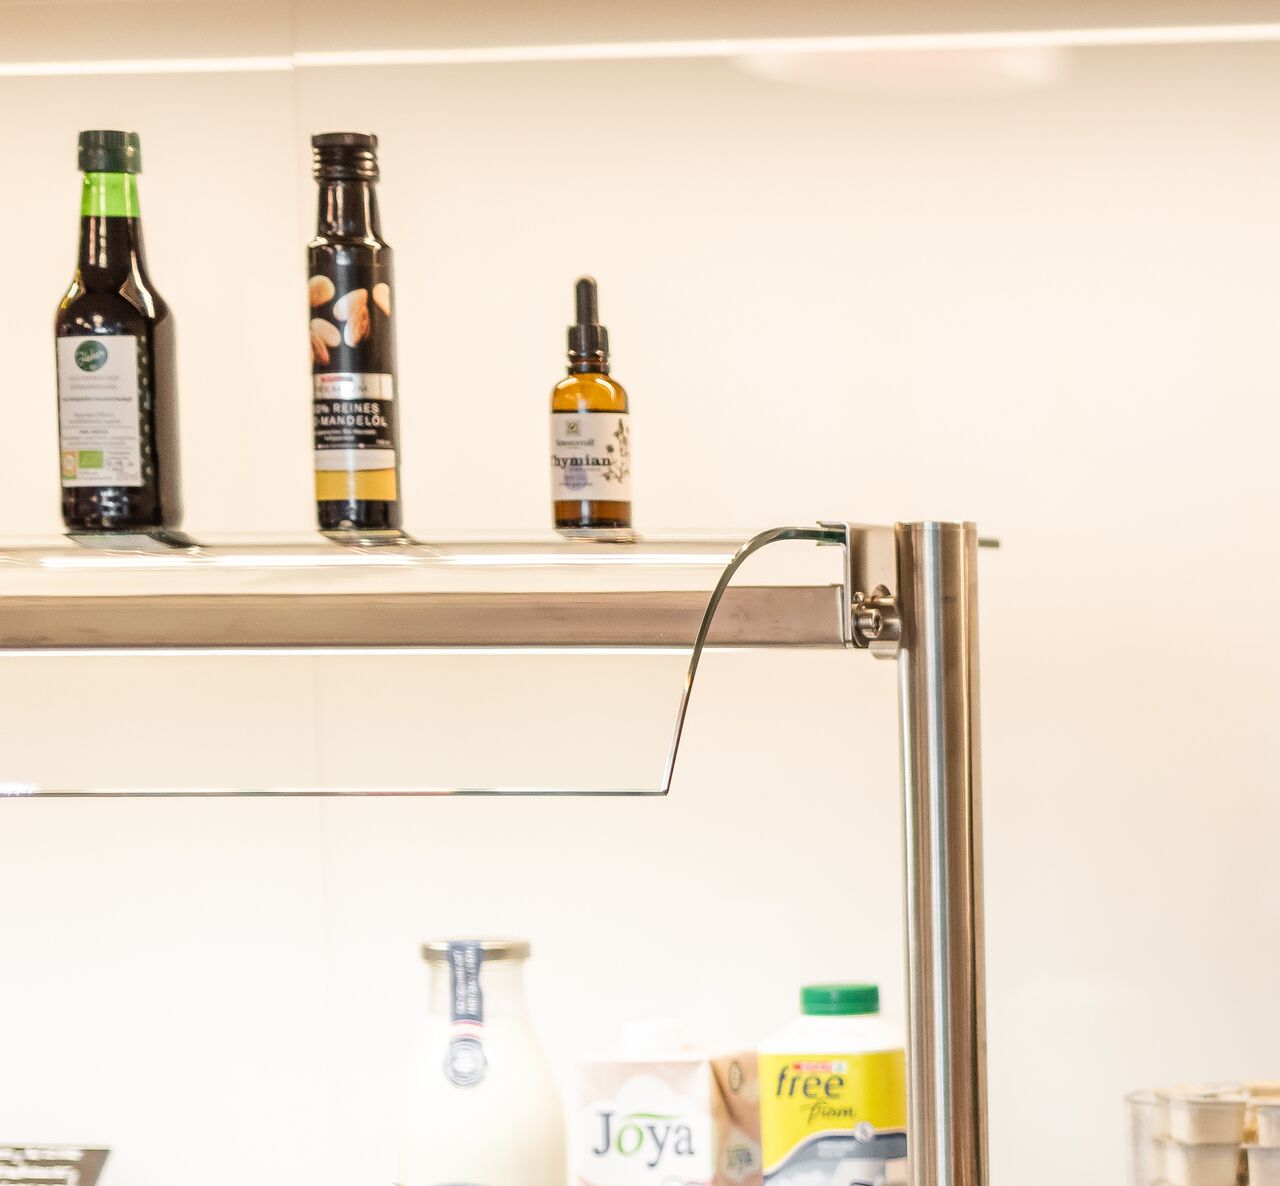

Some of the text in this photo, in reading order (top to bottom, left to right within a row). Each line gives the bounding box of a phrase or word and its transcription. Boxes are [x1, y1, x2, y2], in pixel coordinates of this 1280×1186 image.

[333, 402, 380, 414] REINES
[552, 453, 612, 469] hymian
[775, 1064, 845, 1099] free
[592, 1110, 695, 1168] Joya
